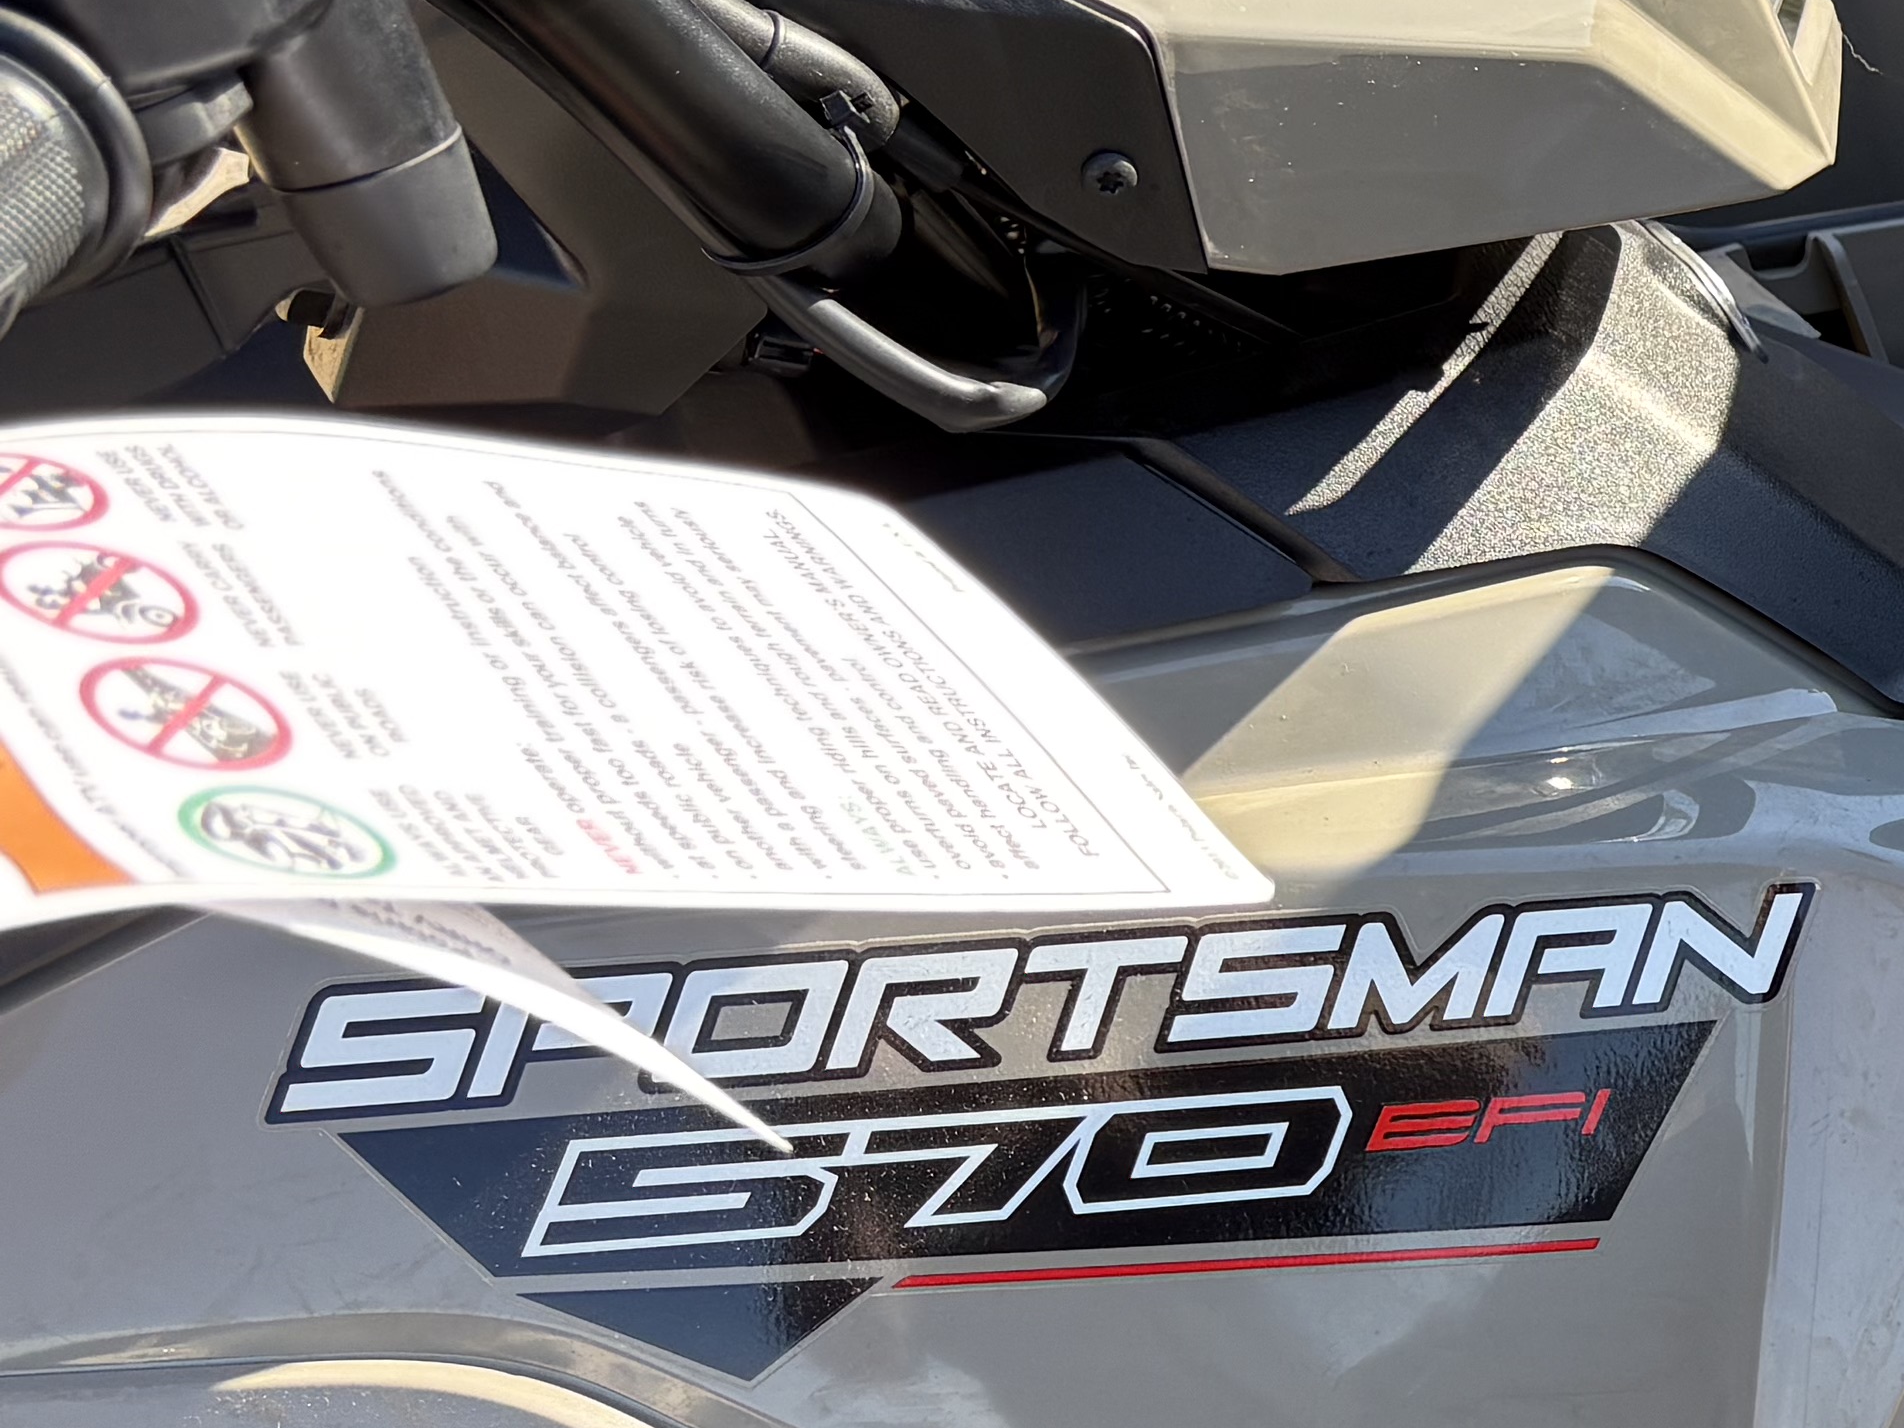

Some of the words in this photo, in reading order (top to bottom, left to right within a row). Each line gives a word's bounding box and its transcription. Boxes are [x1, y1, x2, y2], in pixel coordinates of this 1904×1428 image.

[617, 516, 672, 566] vehicle
[664, 571, 715, 612] avoid
[847, 594, 889, 625] AND
[710, 616, 732, 630] to
[728, 636, 812, 721] techniques
[843, 658, 902, 710] control
[882, 630, 1001, 742] INSTRUCTIONS
[898, 673, 948, 715] READ
[807, 727, 856, 773] riding
[895, 715, 933, 743] and
[942, 721, 984, 755] AND
[928, 749, 996, 818] handling
[997, 749, 1032, 779] ALL
[851, 779, 909, 833] proper
[976, 761, 1046, 828] LOCATE
[1025, 785, 1099, 856] FOLLOW
[902, 839, 936, 868] use
[989, 824, 1039, 869] affect
[266, 882, 1815, 1125] SPORTSMAN
[520, 1085, 1353, 1258] 570
[1365, 1087, 1611, 1152] EFI
